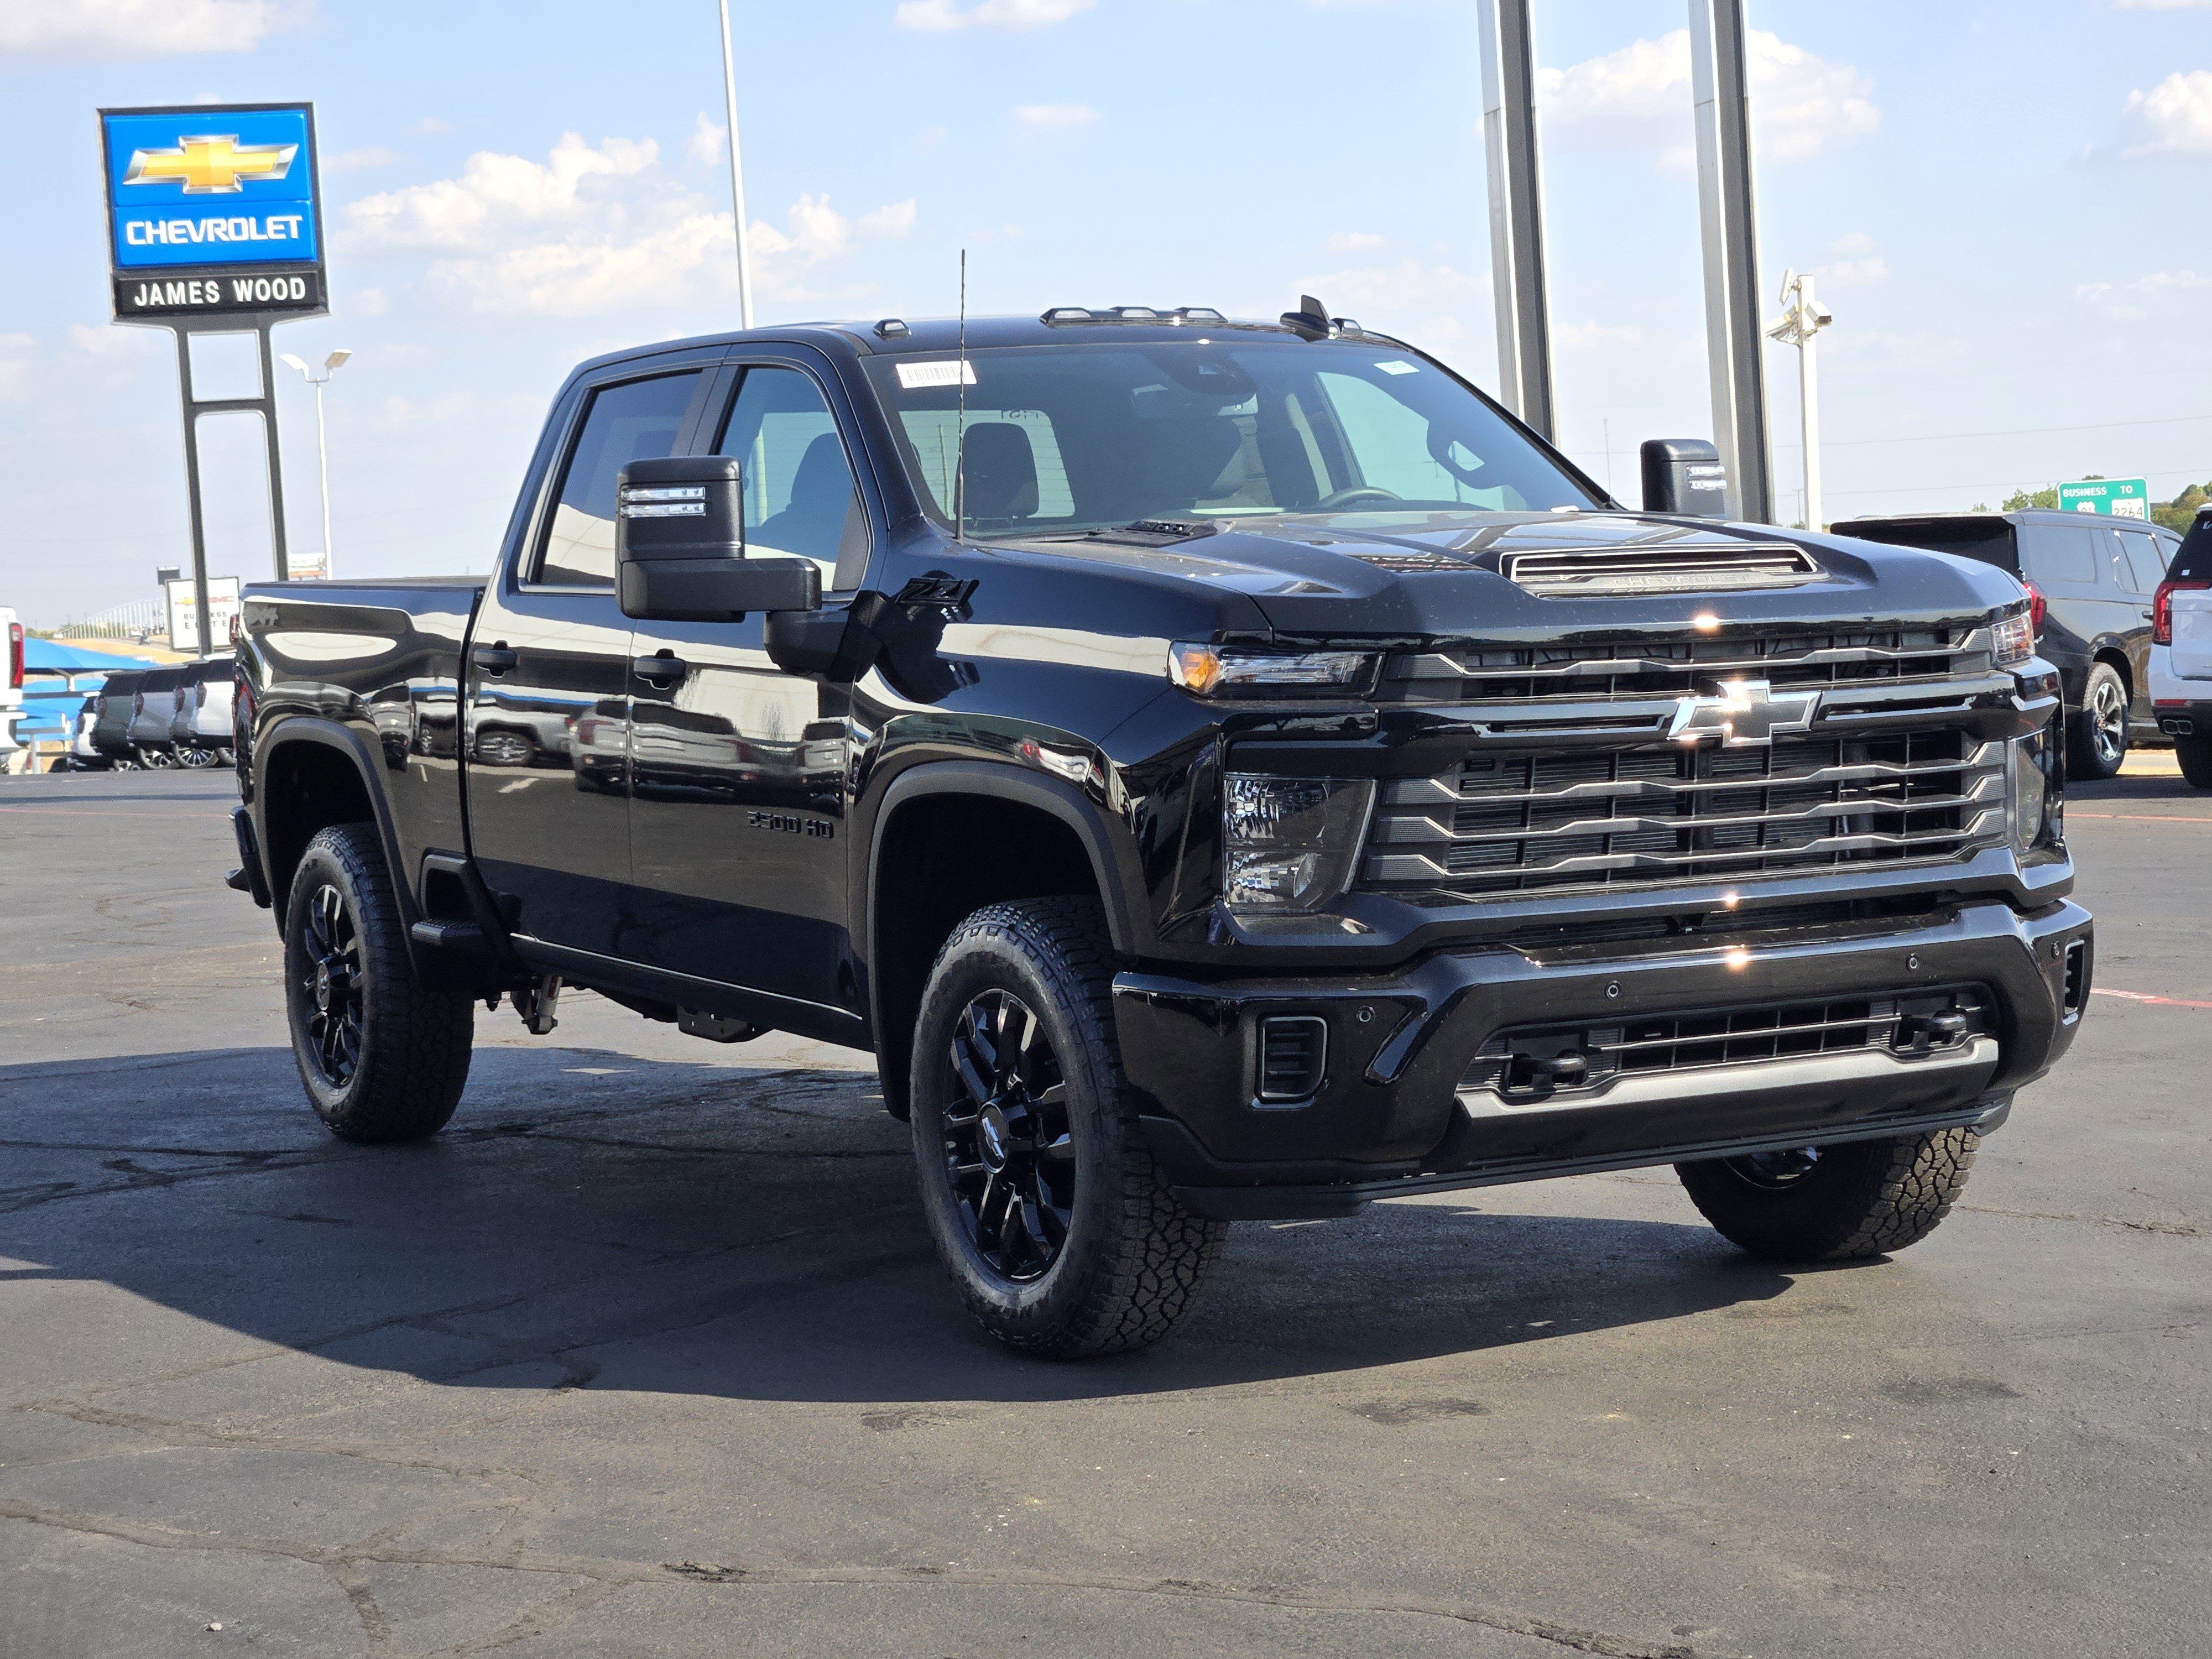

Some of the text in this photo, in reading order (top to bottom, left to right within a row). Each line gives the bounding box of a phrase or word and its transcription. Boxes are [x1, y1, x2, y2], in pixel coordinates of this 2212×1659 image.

[126, 216, 303, 246] CHEVROLET
[134, 278, 306, 307] JAMES WOOD
[2062, 485, 2133, 498] BUSINESS TO
[1612, 575, 1750, 587] CHEVROLET
